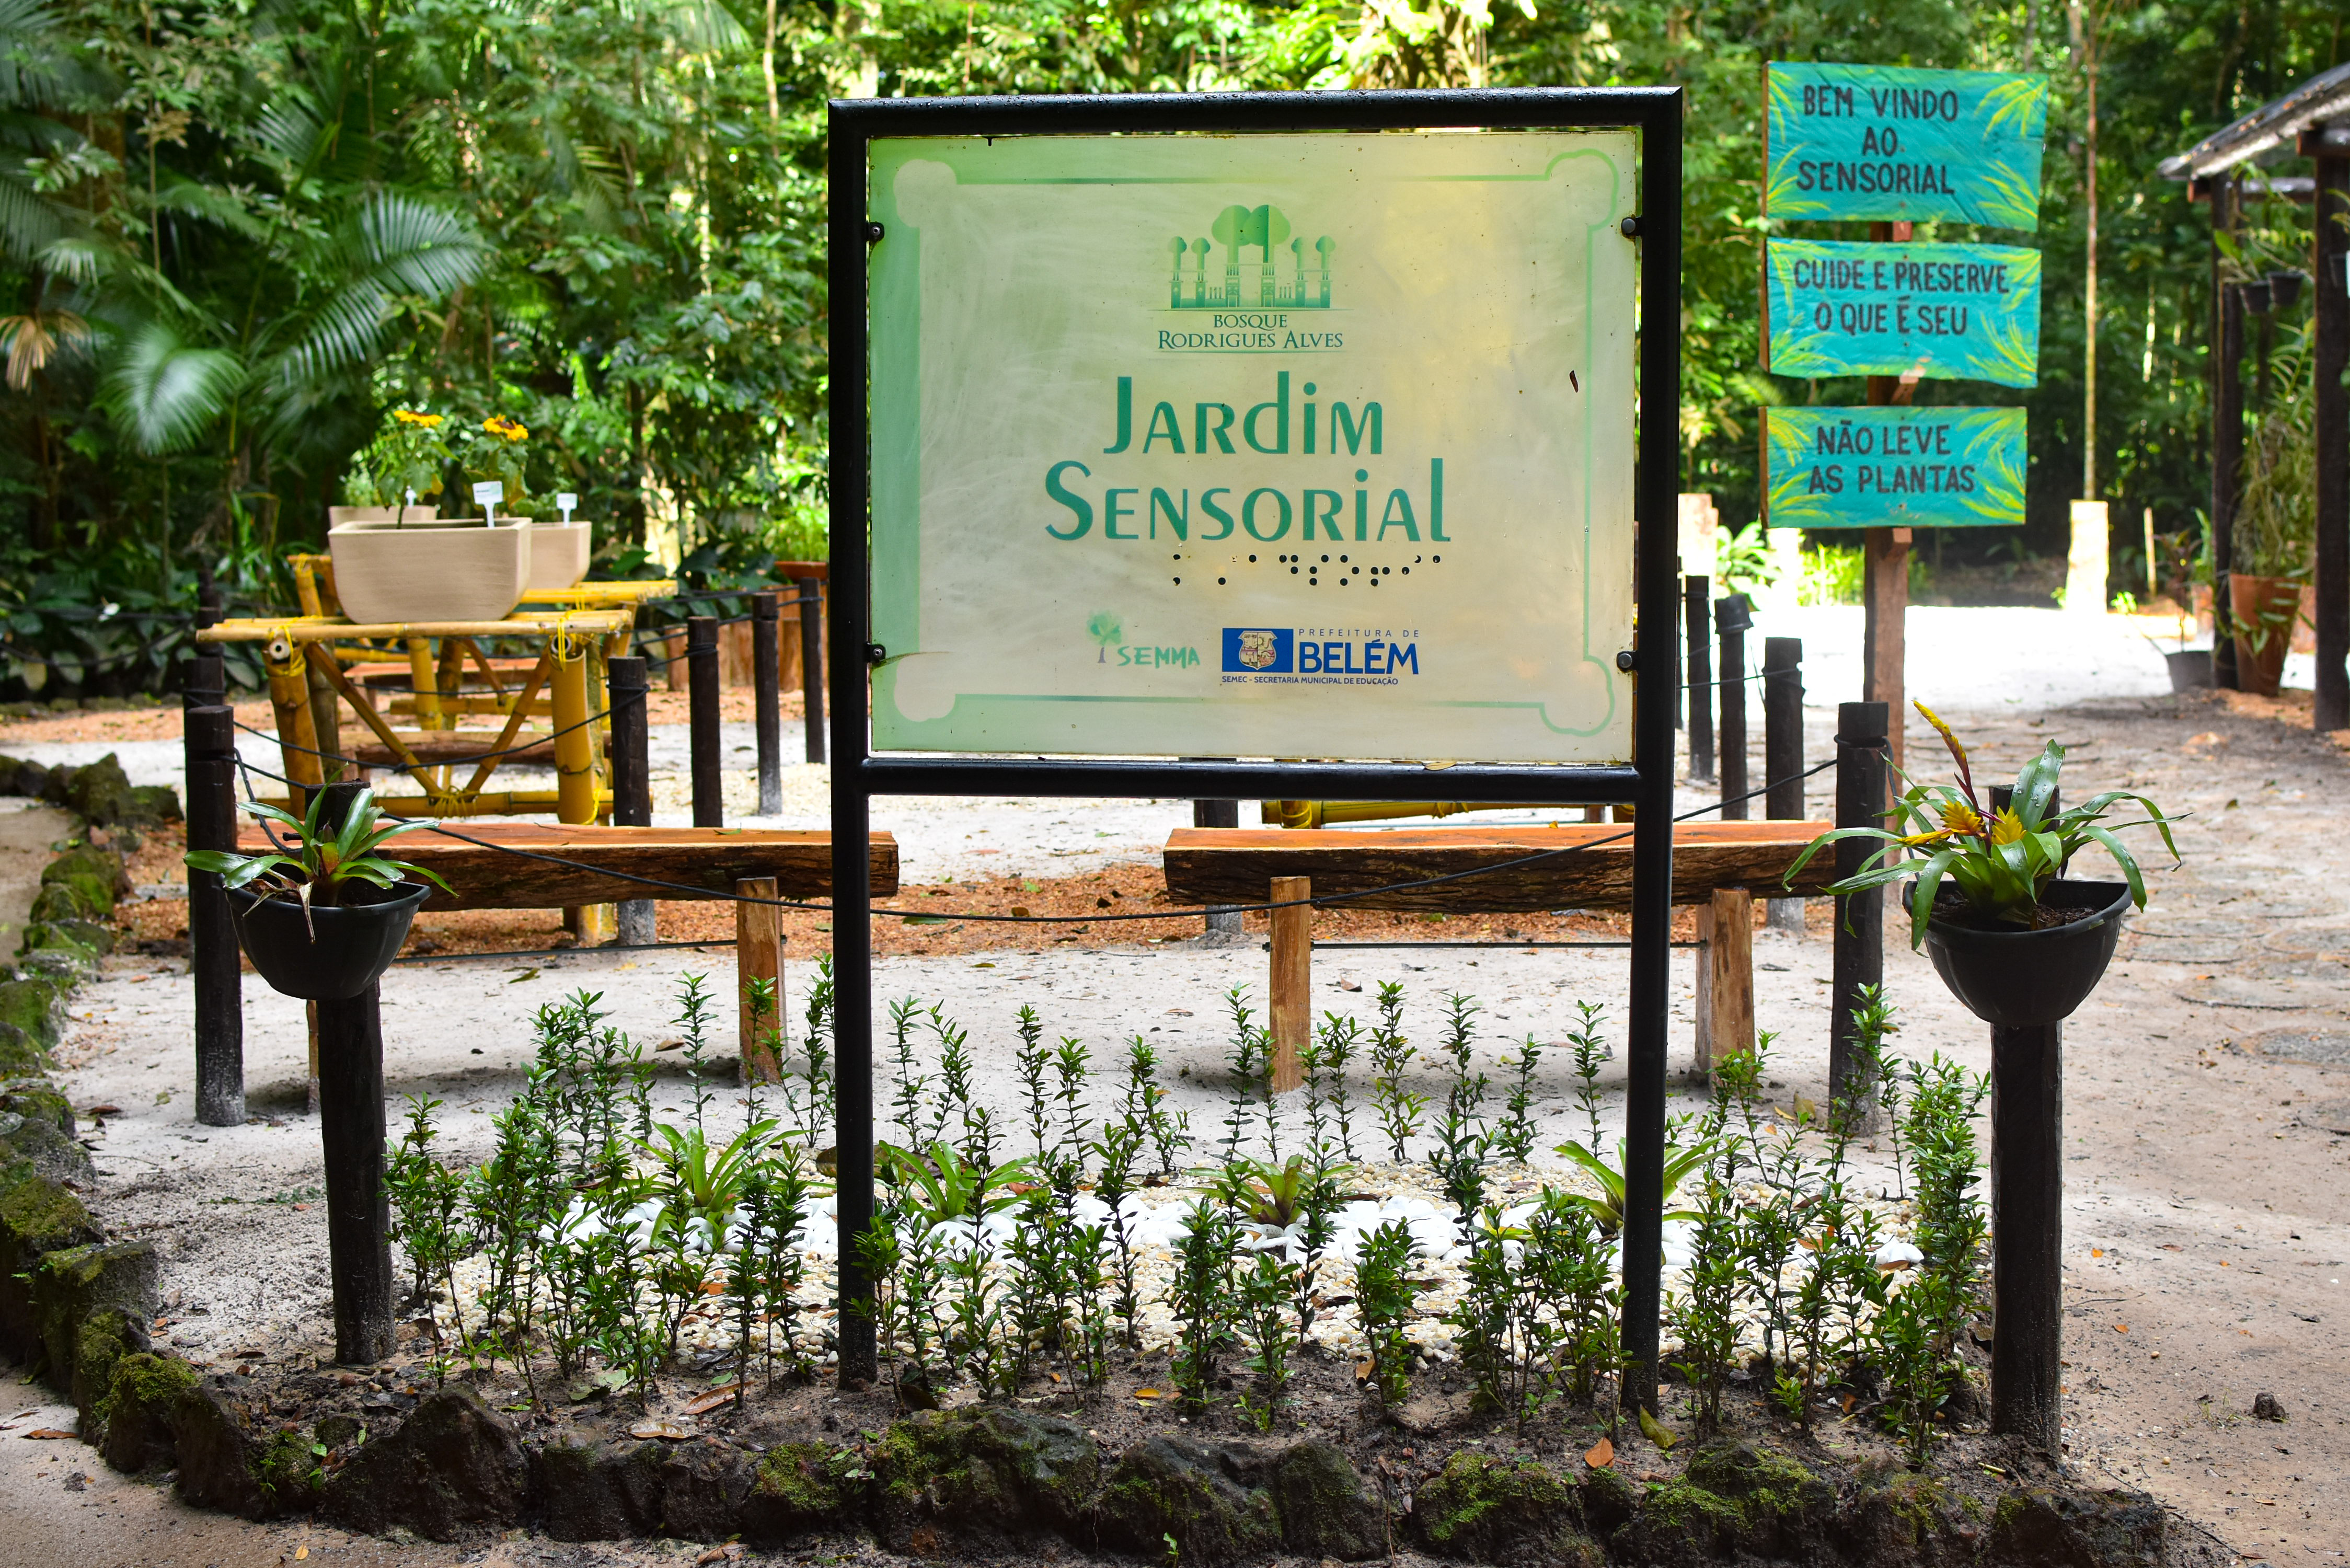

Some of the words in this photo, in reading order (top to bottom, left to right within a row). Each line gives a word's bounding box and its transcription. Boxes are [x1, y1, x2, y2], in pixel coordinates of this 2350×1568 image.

[1804, 84, 1854, 118] BEM
[1871, 87, 1959, 122] VINDO
[1862, 126, 1899, 157] AO
[1796, 160, 1955, 196] SENSORIAL
[1794, 259, 1865, 290] CUIDE
[1874, 261, 1888, 290] E
[1894, 262, 2010, 293] PRESERVE
[1213, 314, 1287, 330] BOSQUE
[1814, 303, 1832, 331] O
[1840, 303, 1887, 336] QUE
[1897, 295, 1910, 334] É
[1917, 306, 1967, 336] SEU
[1817, 419, 1874, 455] NÃO
[1883, 424, 1951, 455] LEVE
[1808, 465, 1844, 494] AS
[1858, 465, 1975, 493] PLANTAS
[1118, 645, 1201, 668] SEMMA
[1299, 639, 1419, 674] BELÉM
[1356, 677, 1398, 686] EDUCAÇÃO
